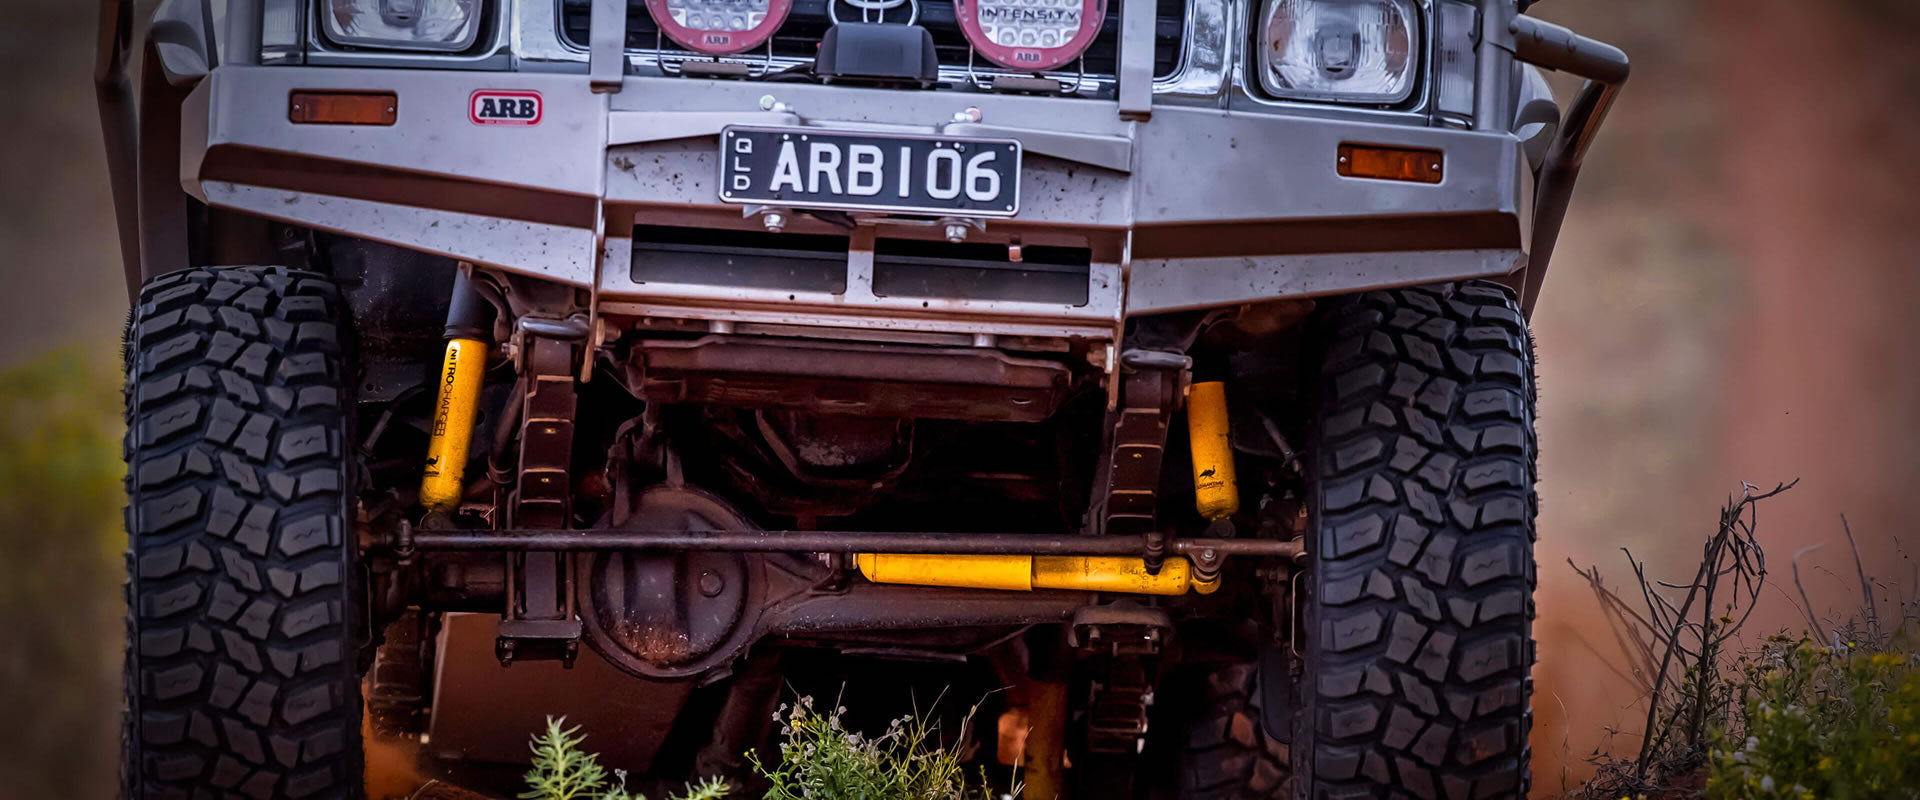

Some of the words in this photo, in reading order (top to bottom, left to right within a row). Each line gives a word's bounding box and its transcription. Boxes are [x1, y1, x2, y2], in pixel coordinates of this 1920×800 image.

[981, 7, 1077, 20] INTENSITY
[705, 35, 729, 45] ARB
[1015, 52, 1040, 62] ARB
[479, 98, 536, 118] ARB
[733, 138, 752, 190] QLD
[436, 348, 458, 437] NITROCHARGER
